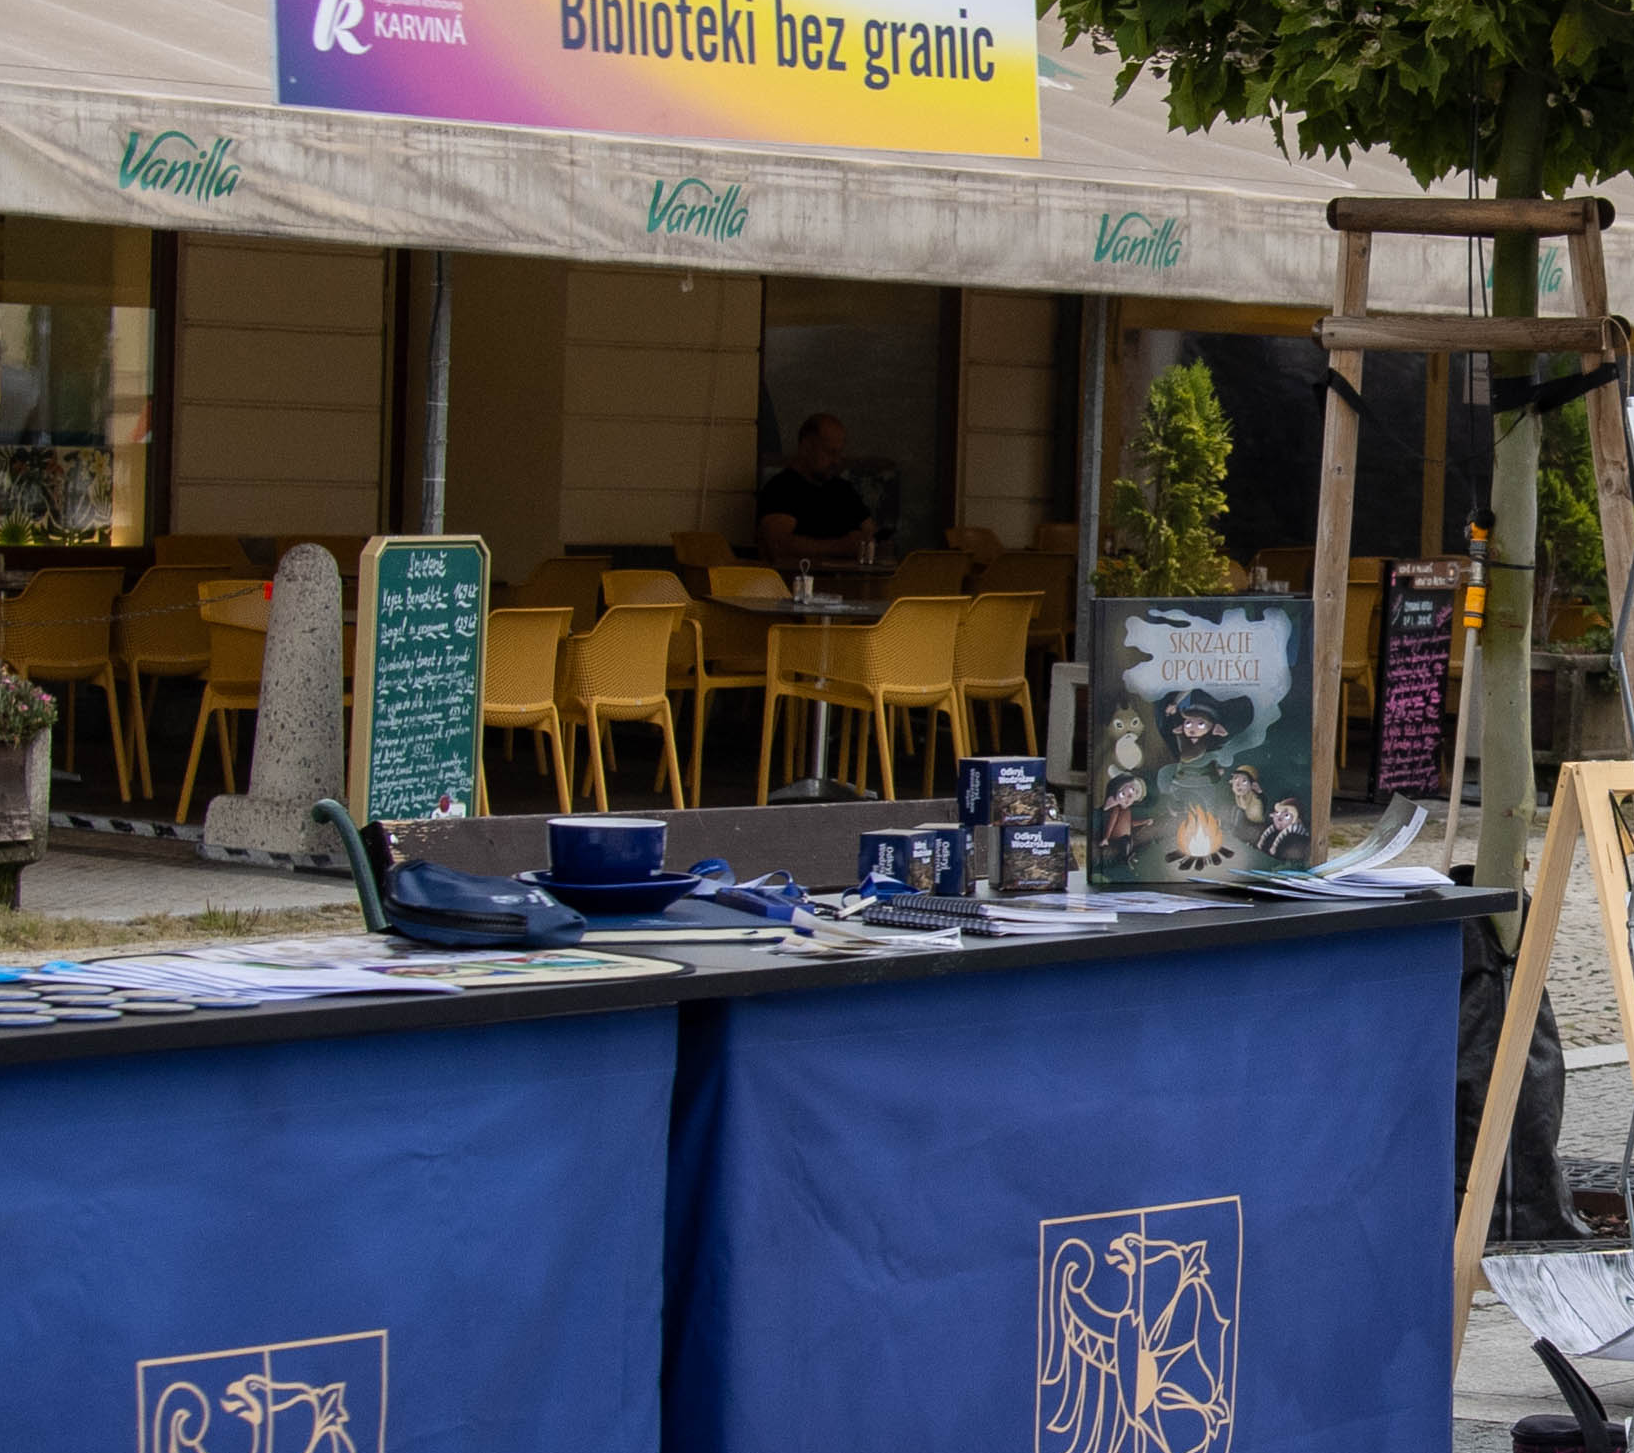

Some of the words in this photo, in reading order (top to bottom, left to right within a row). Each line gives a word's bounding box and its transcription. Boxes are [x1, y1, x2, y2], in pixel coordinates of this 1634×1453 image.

[374, 11, 468, 46] KARVINÁ
[865, 8, 996, 90] granic
[118, 130, 242, 203] Vanilla
[645, 177, 749, 244] Vanilla
[1094, 211, 1183, 272] Vanilla
[1160, 656, 1260, 682] OPOWIEŚCI
[998, 775, 1036, 784] Wodzisław
[1000, 766, 1024, 777] Odkryj
[1011, 839, 1056, 849] Wodzisław
[1014, 831, 1042, 841] Odkryj
